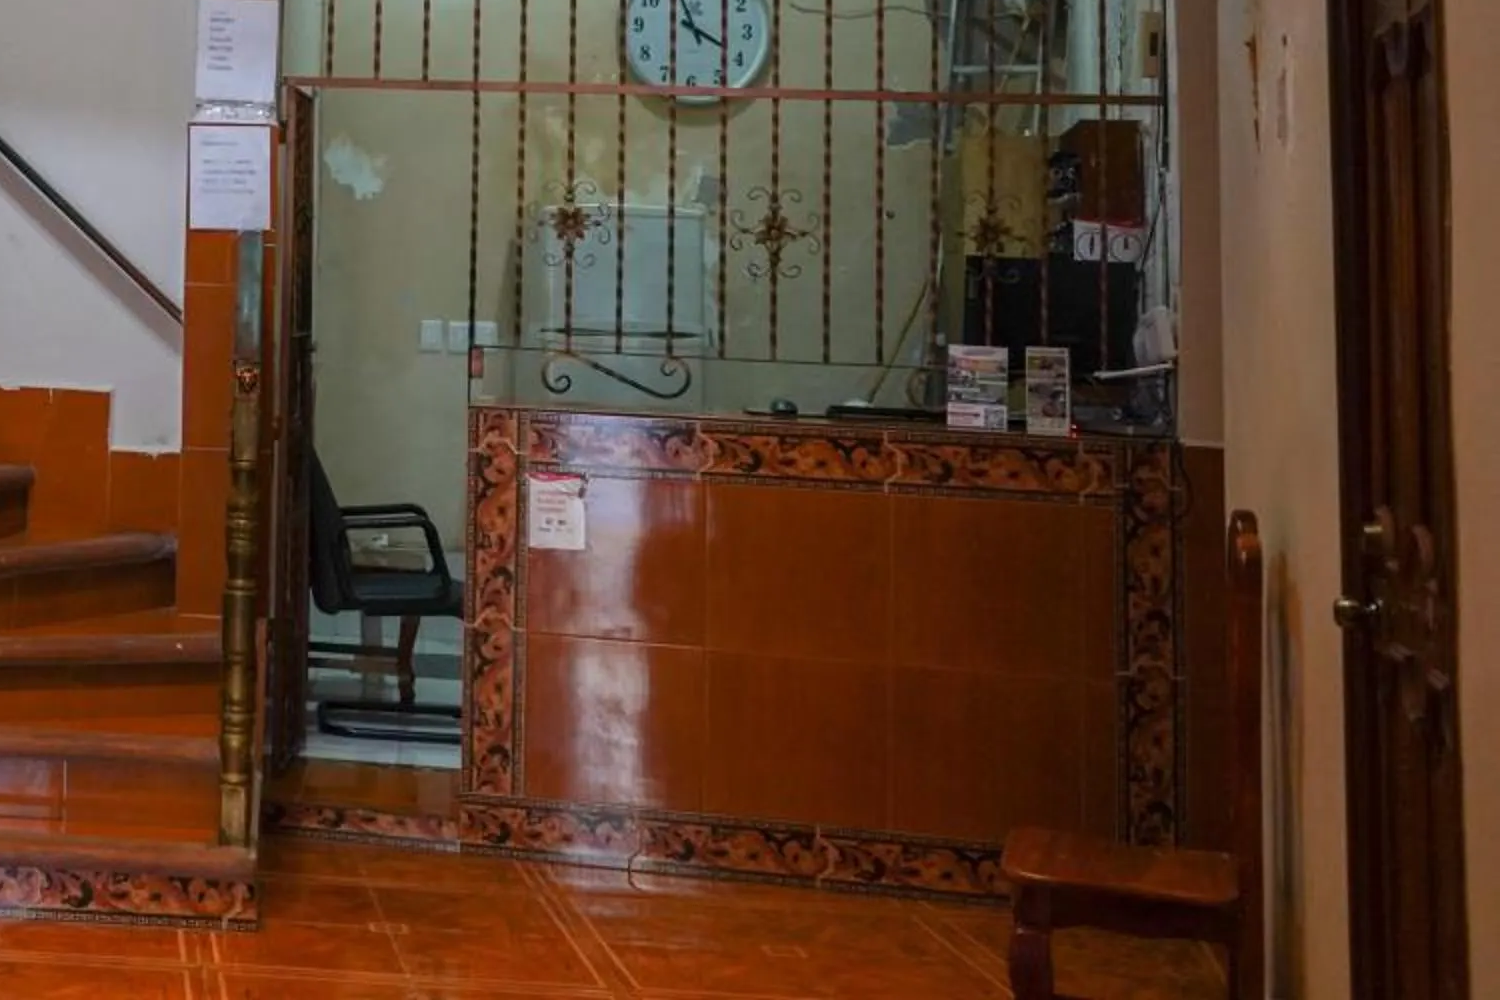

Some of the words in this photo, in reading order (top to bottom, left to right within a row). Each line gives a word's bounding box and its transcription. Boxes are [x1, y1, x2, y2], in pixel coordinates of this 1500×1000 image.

[633, 17, 646, 33] 9
[742, 24, 754, 41] 3
[639, 45, 652, 61] 8
[732, 51, 744, 67] 4
[659, 65, 670, 83] 7
